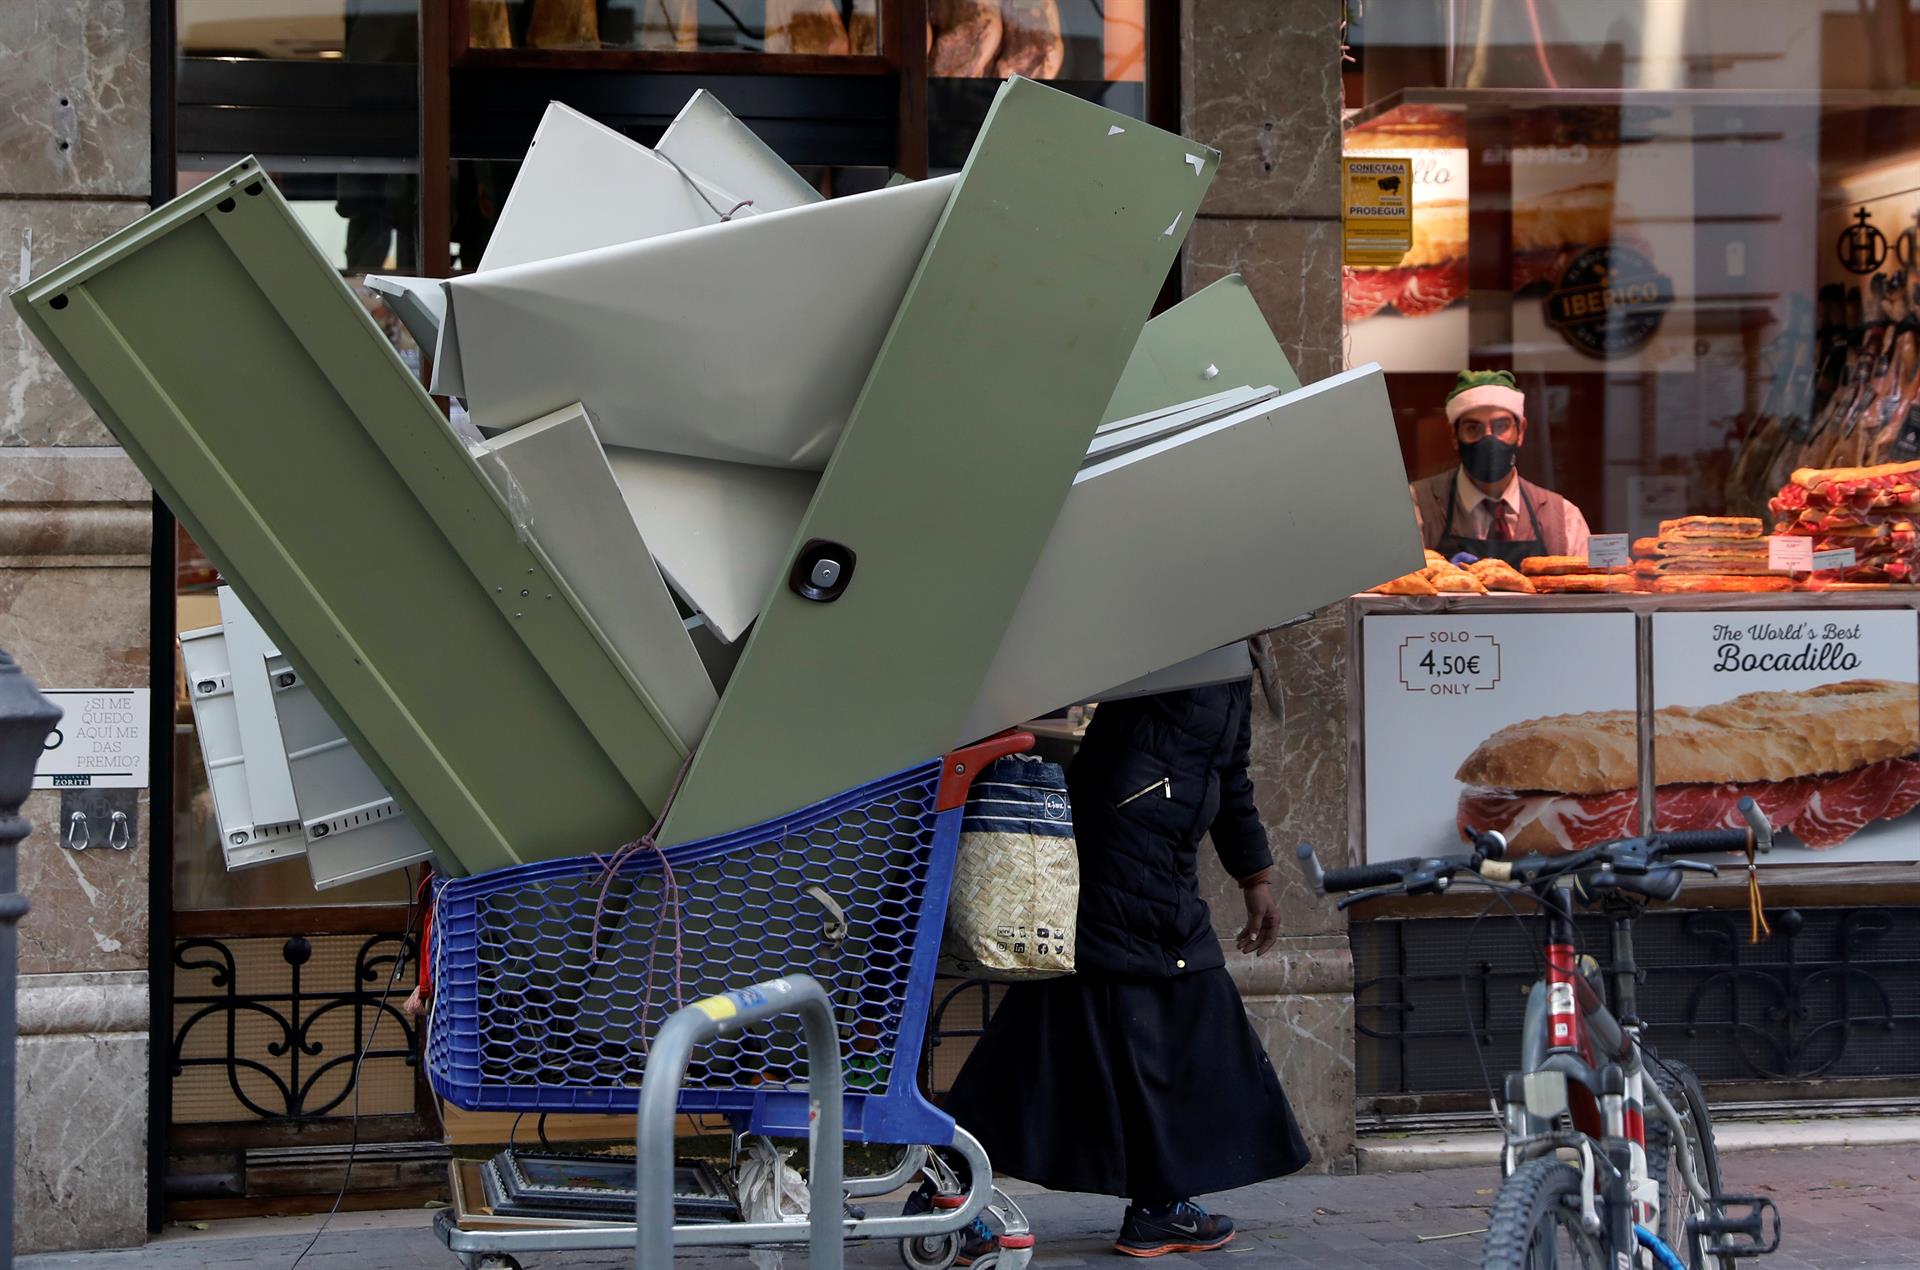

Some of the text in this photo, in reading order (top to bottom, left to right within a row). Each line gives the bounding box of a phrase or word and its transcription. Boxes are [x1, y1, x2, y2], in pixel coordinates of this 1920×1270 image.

[1349, 163, 1405, 172] CONECTADA
[1349, 206, 1406, 216] PROSEGUR
[1561, 281, 1660, 318] IBERICO
[1430, 631, 1469, 643] SOLO
[1712, 621, 1862, 641] The World's Best
[1419, 649, 1480, 677] 4,50€
[1713, 642, 1862, 672] Bocadillo
[1430, 683, 1470, 695] ONLY
[84, 698, 131, 712] ¿SI ME
[81, 712, 133, 724] QUEDO
[76, 726, 138, 739] AQUÍ ME
[92, 742, 122, 753] DAS
[77, 756, 141, 768] PREMIO?
